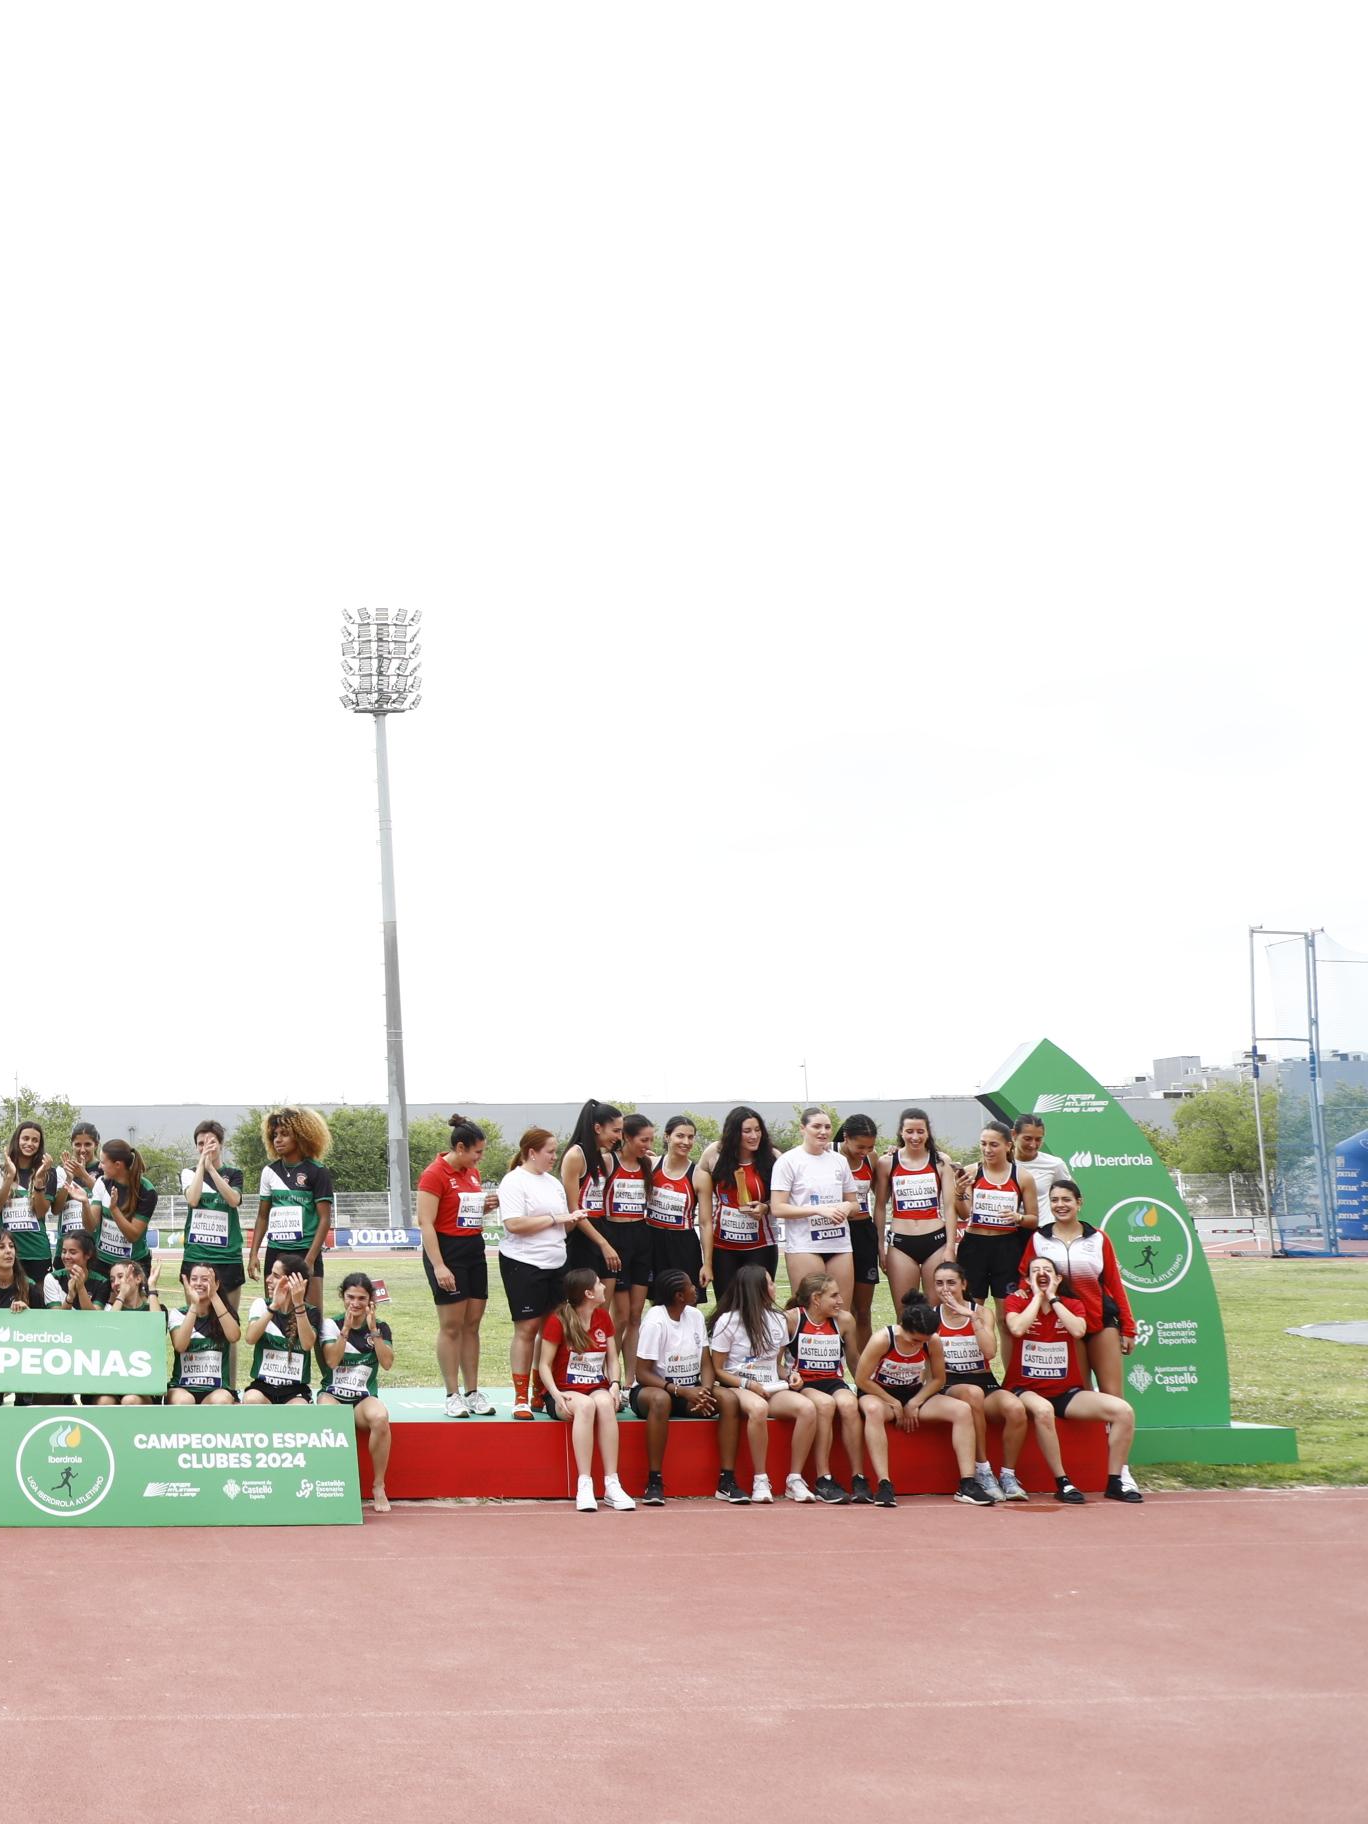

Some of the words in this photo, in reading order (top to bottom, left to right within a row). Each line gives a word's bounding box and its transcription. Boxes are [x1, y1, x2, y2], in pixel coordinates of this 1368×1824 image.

[1094, 1154, 1152, 1166] Iberdrola
[896, 1188, 922, 1197] CASTELLÓ
[924, 1187, 936, 1195] 2024
[3, 1209, 27, 1219] CASTELLÓ
[193, 1222, 215, 1231] CASTELLÓ
[216, 1224, 227, 1232] 2024
[270, 1220, 288, 1228] CASTELLÓ
[289, 1219, 300, 1227] 2024
[722, 1218, 745, 1229] CASTELLÓ
[746, 1221, 757, 1229] 2024
[1159, 1254, 1183, 1282] ATLETISMO
[1156, 1320, 1198, 1329] Castellón
[13, 1330, 72, 1344] Iberdrola
[1159, 1337, 1197, 1346] Deportivo
[800, 1347, 828, 1357] CASTELLÓ
[829, 1348, 839, 1357] 2024
[969, 1349, 981, 1357] 2024
[1024, 1354, 1052, 1364] CASTELLÓ
[1053, 1355, 1066, 1364] 2024
[183, 1364, 207, 1373] CASTELLÓ
[208, 1365, 220, 1373] 2024
[262, 1363, 287, 1374] CASTELLÓ
[287, 1366, 300, 1375] 2024
[334, 1376, 357, 1386] CASTELLÓ
[1155, 1373, 1198, 1384] Castelló
[134, 1433, 268, 1449] CAMPEONATO
[273, 1428, 349, 1448] ESPAÑA
[178, 1453, 252, 1468] CLUBES
[256, 1453, 306, 1468] 2024
[27, 1476, 37, 1492] LIGA
[37, 1490, 75, 1507] IBERDROLA
[76, 1476, 104, 1505] ATLETISMO
[242, 1485, 272, 1494] Castelló
